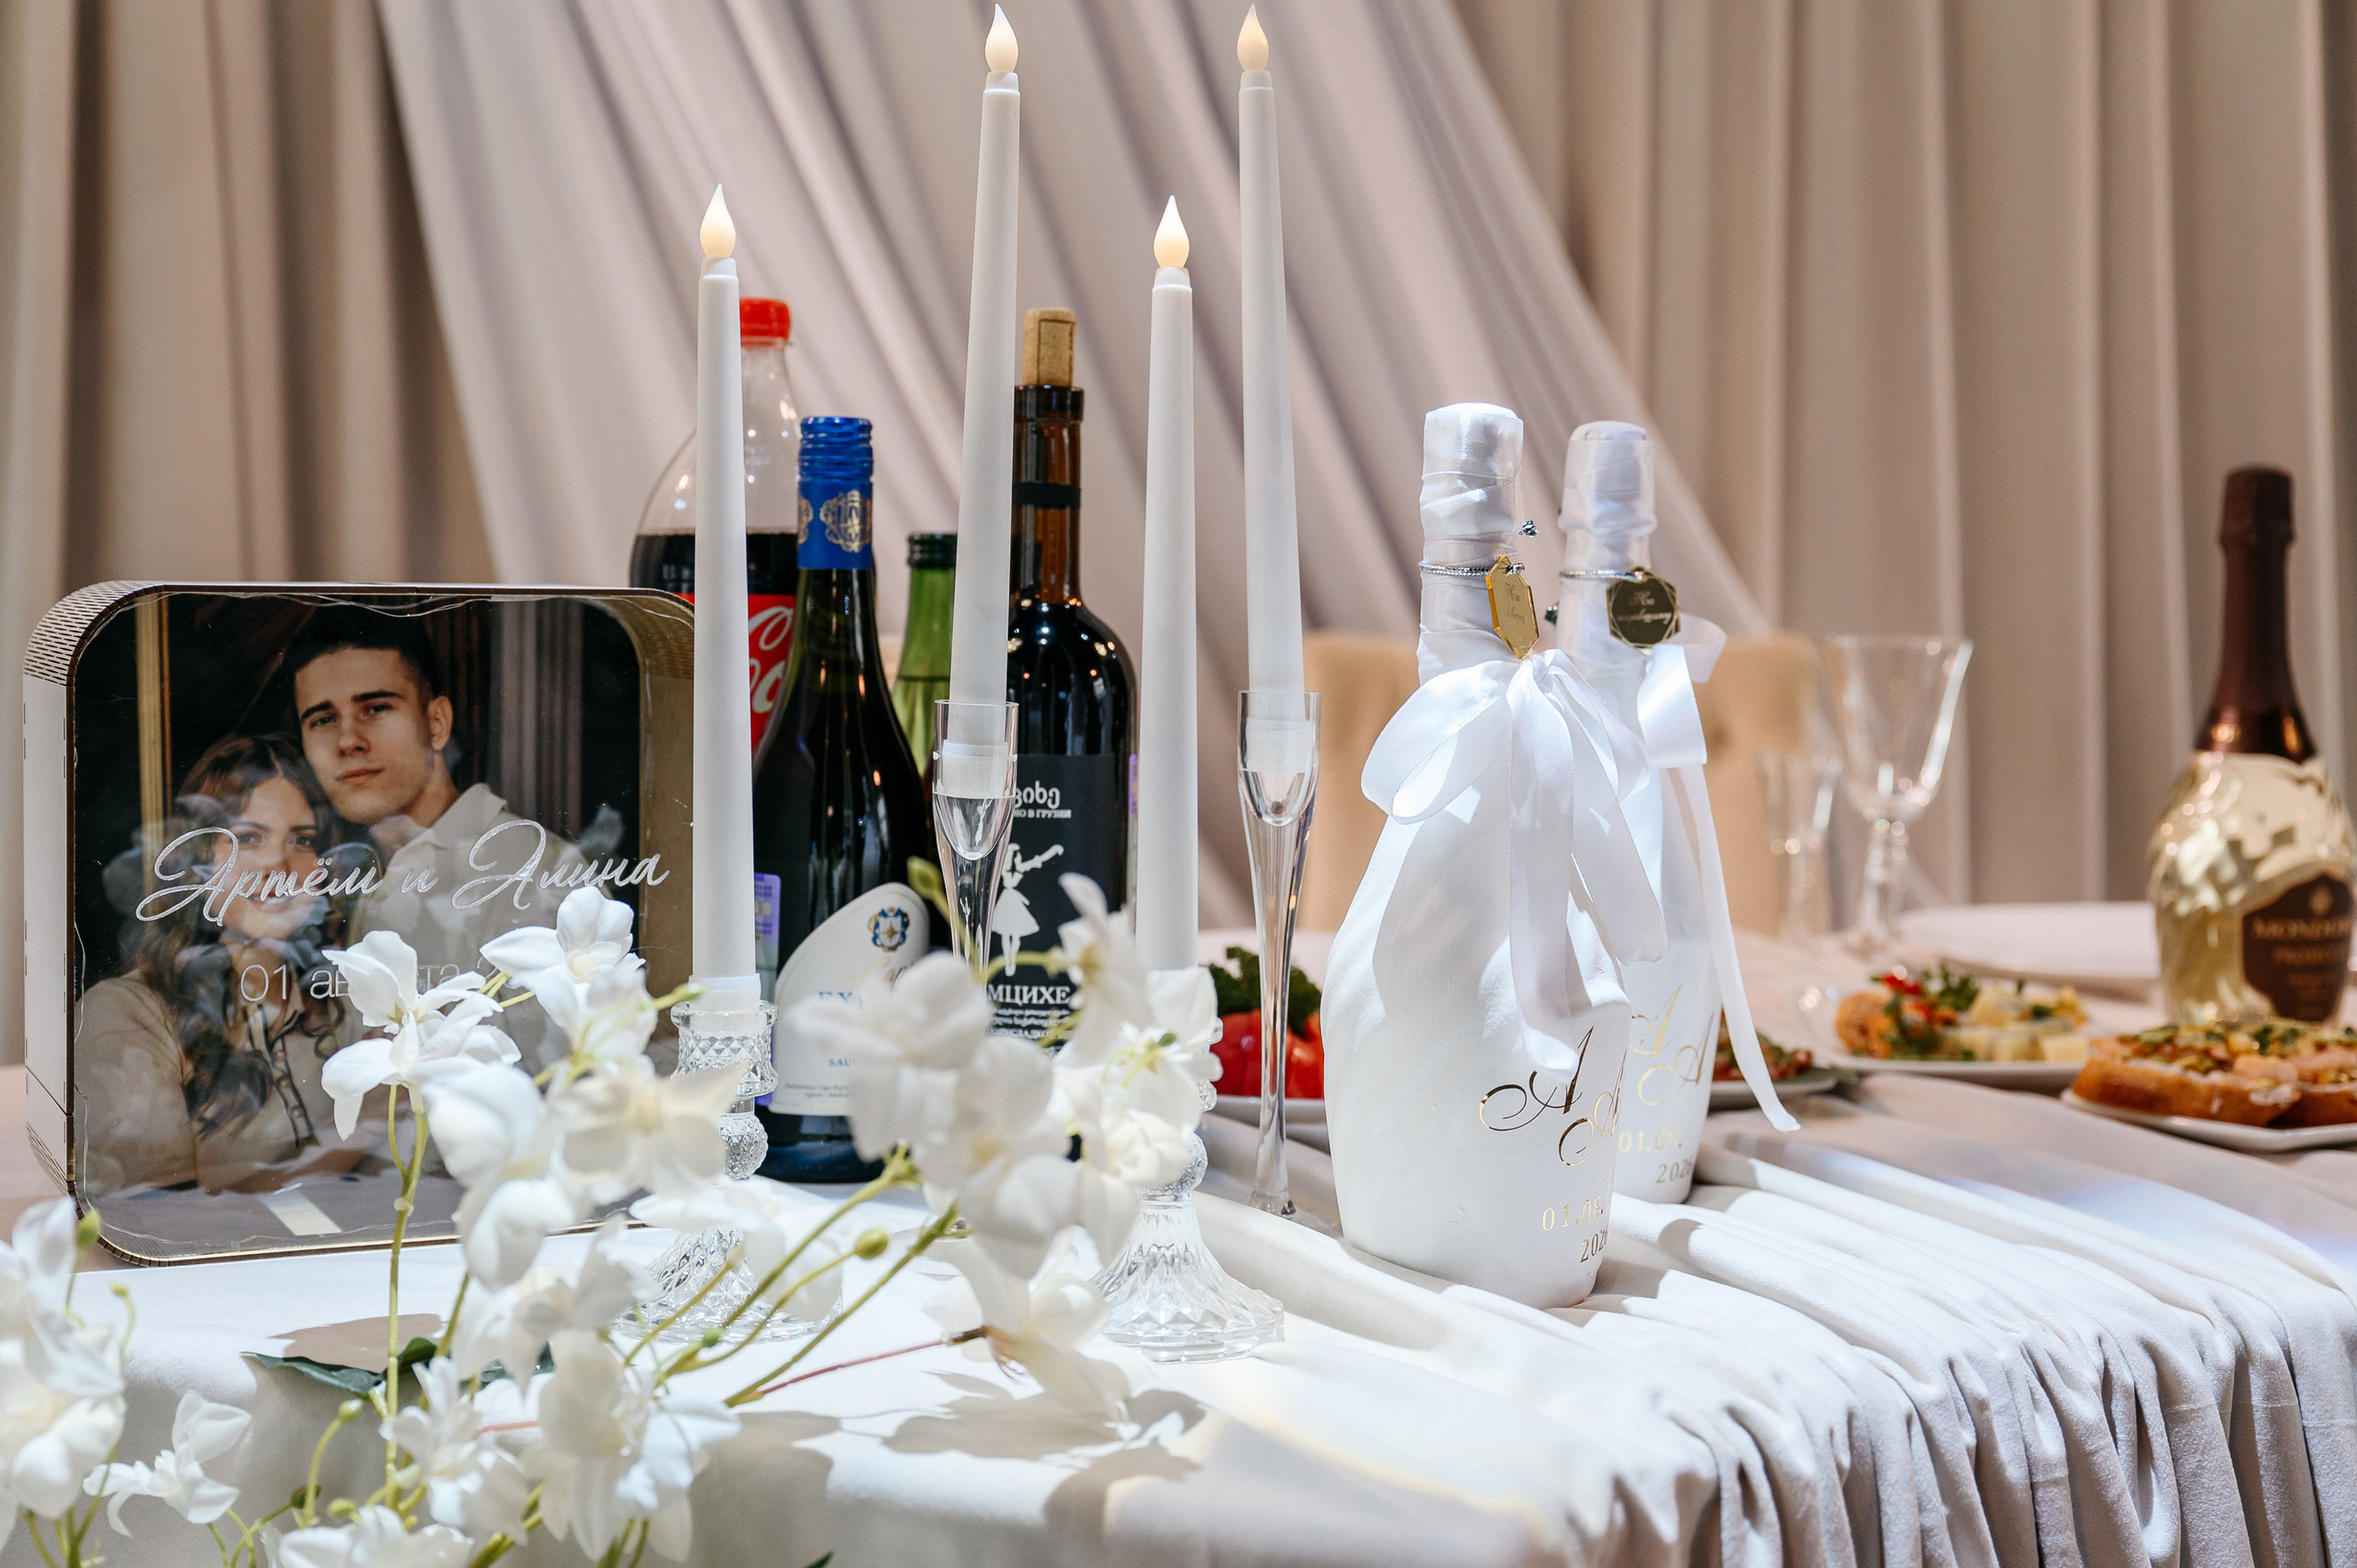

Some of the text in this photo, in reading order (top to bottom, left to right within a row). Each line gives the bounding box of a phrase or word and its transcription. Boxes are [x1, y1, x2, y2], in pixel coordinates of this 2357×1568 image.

[135, 826, 384, 927] Артём
[401, 869, 439, 893] и
[450, 819, 671, 912] Алина
[239, 963, 288, 1002] 01
[986, 983, 1072, 1007] МЦИХЕ
[1541, 1195, 1604, 1232] 01.08.
